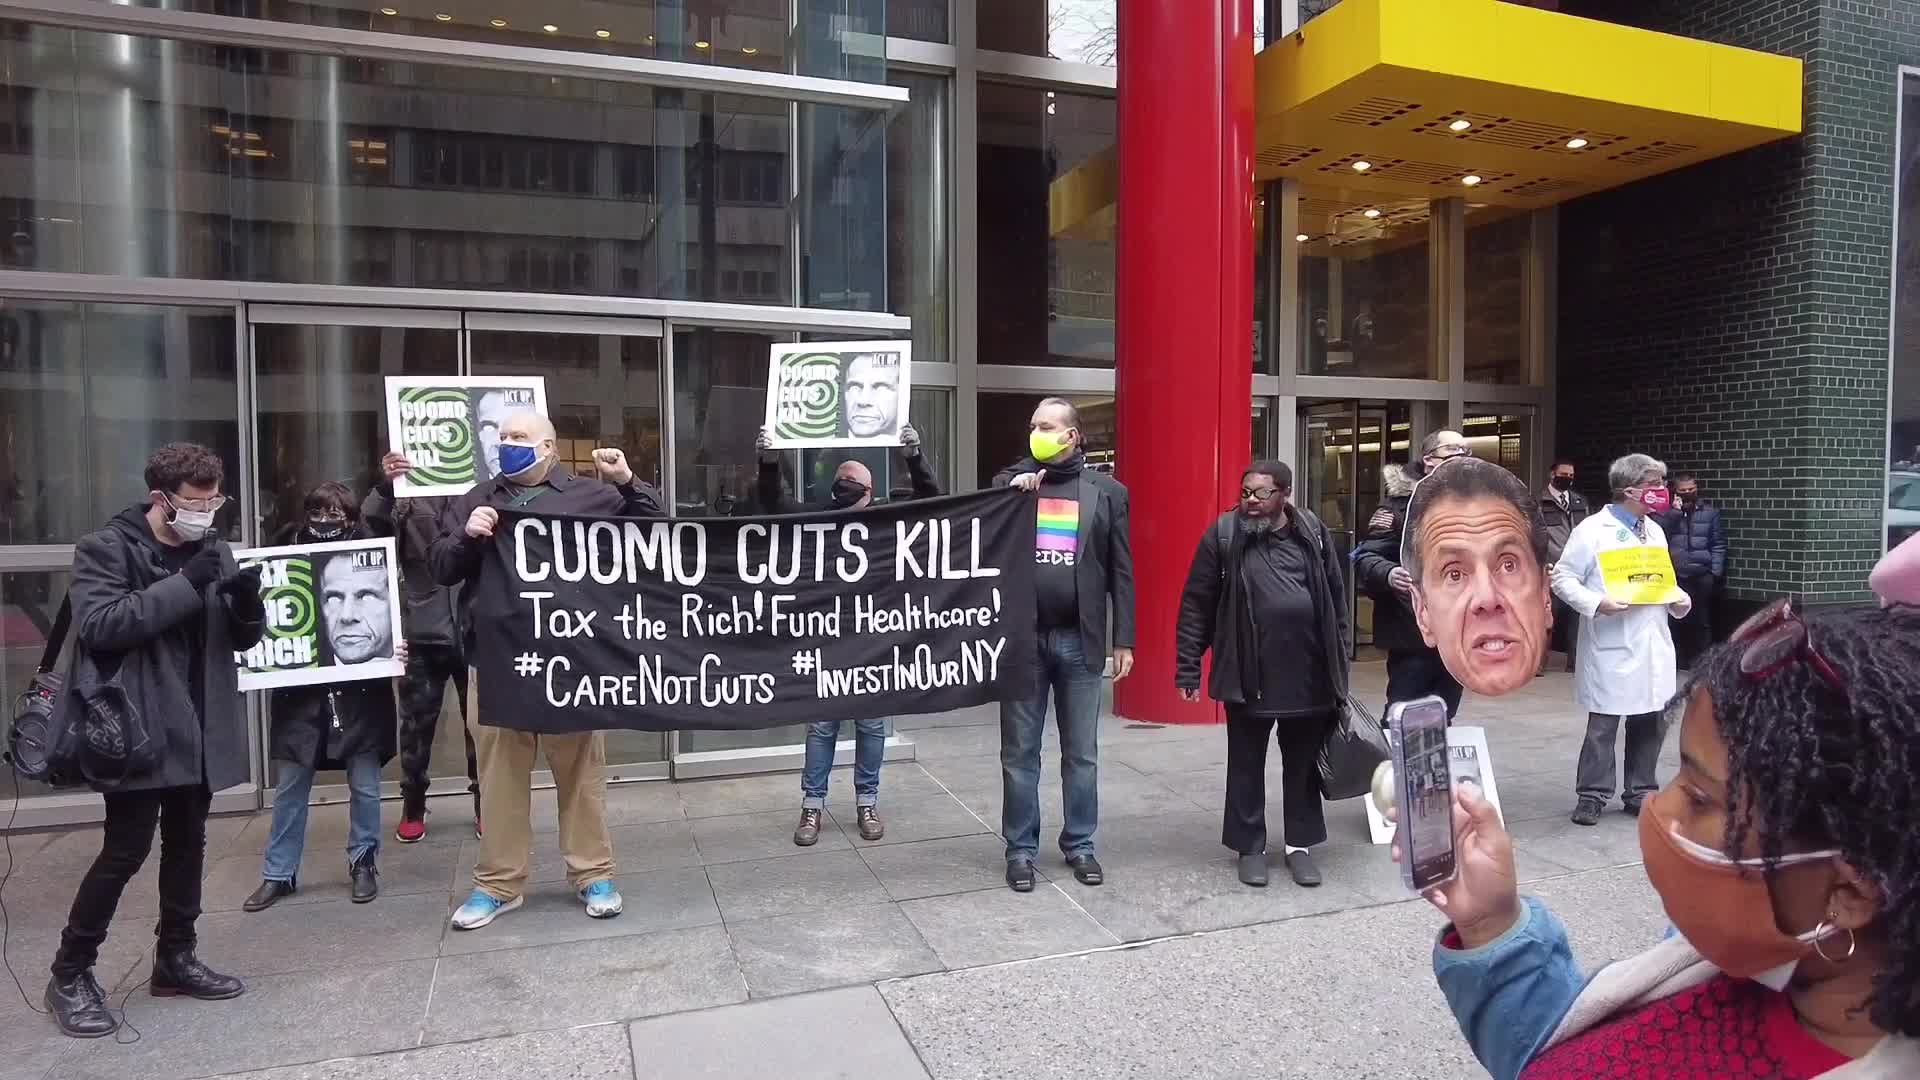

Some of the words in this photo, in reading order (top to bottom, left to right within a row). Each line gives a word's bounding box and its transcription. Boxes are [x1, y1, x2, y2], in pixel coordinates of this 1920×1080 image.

[401, 400, 467, 419] CUOMO
[402, 425, 452, 446] CUTS
[352, 552, 367, 567] ACT
[370, 551, 383, 566] UP
[514, 518, 707, 586] CUOMO
[737, 522, 869, 585] CUTS
[895, 517, 1000, 581] KILL
[263, 598, 294, 626] HE
[519, 591, 597, 639] Tax
[613, 593, 667, 640] the
[681, 590, 764, 638] Rich!
[771, 594, 840, 638] Fund
[854, 588, 1001, 633] Healthcare!
